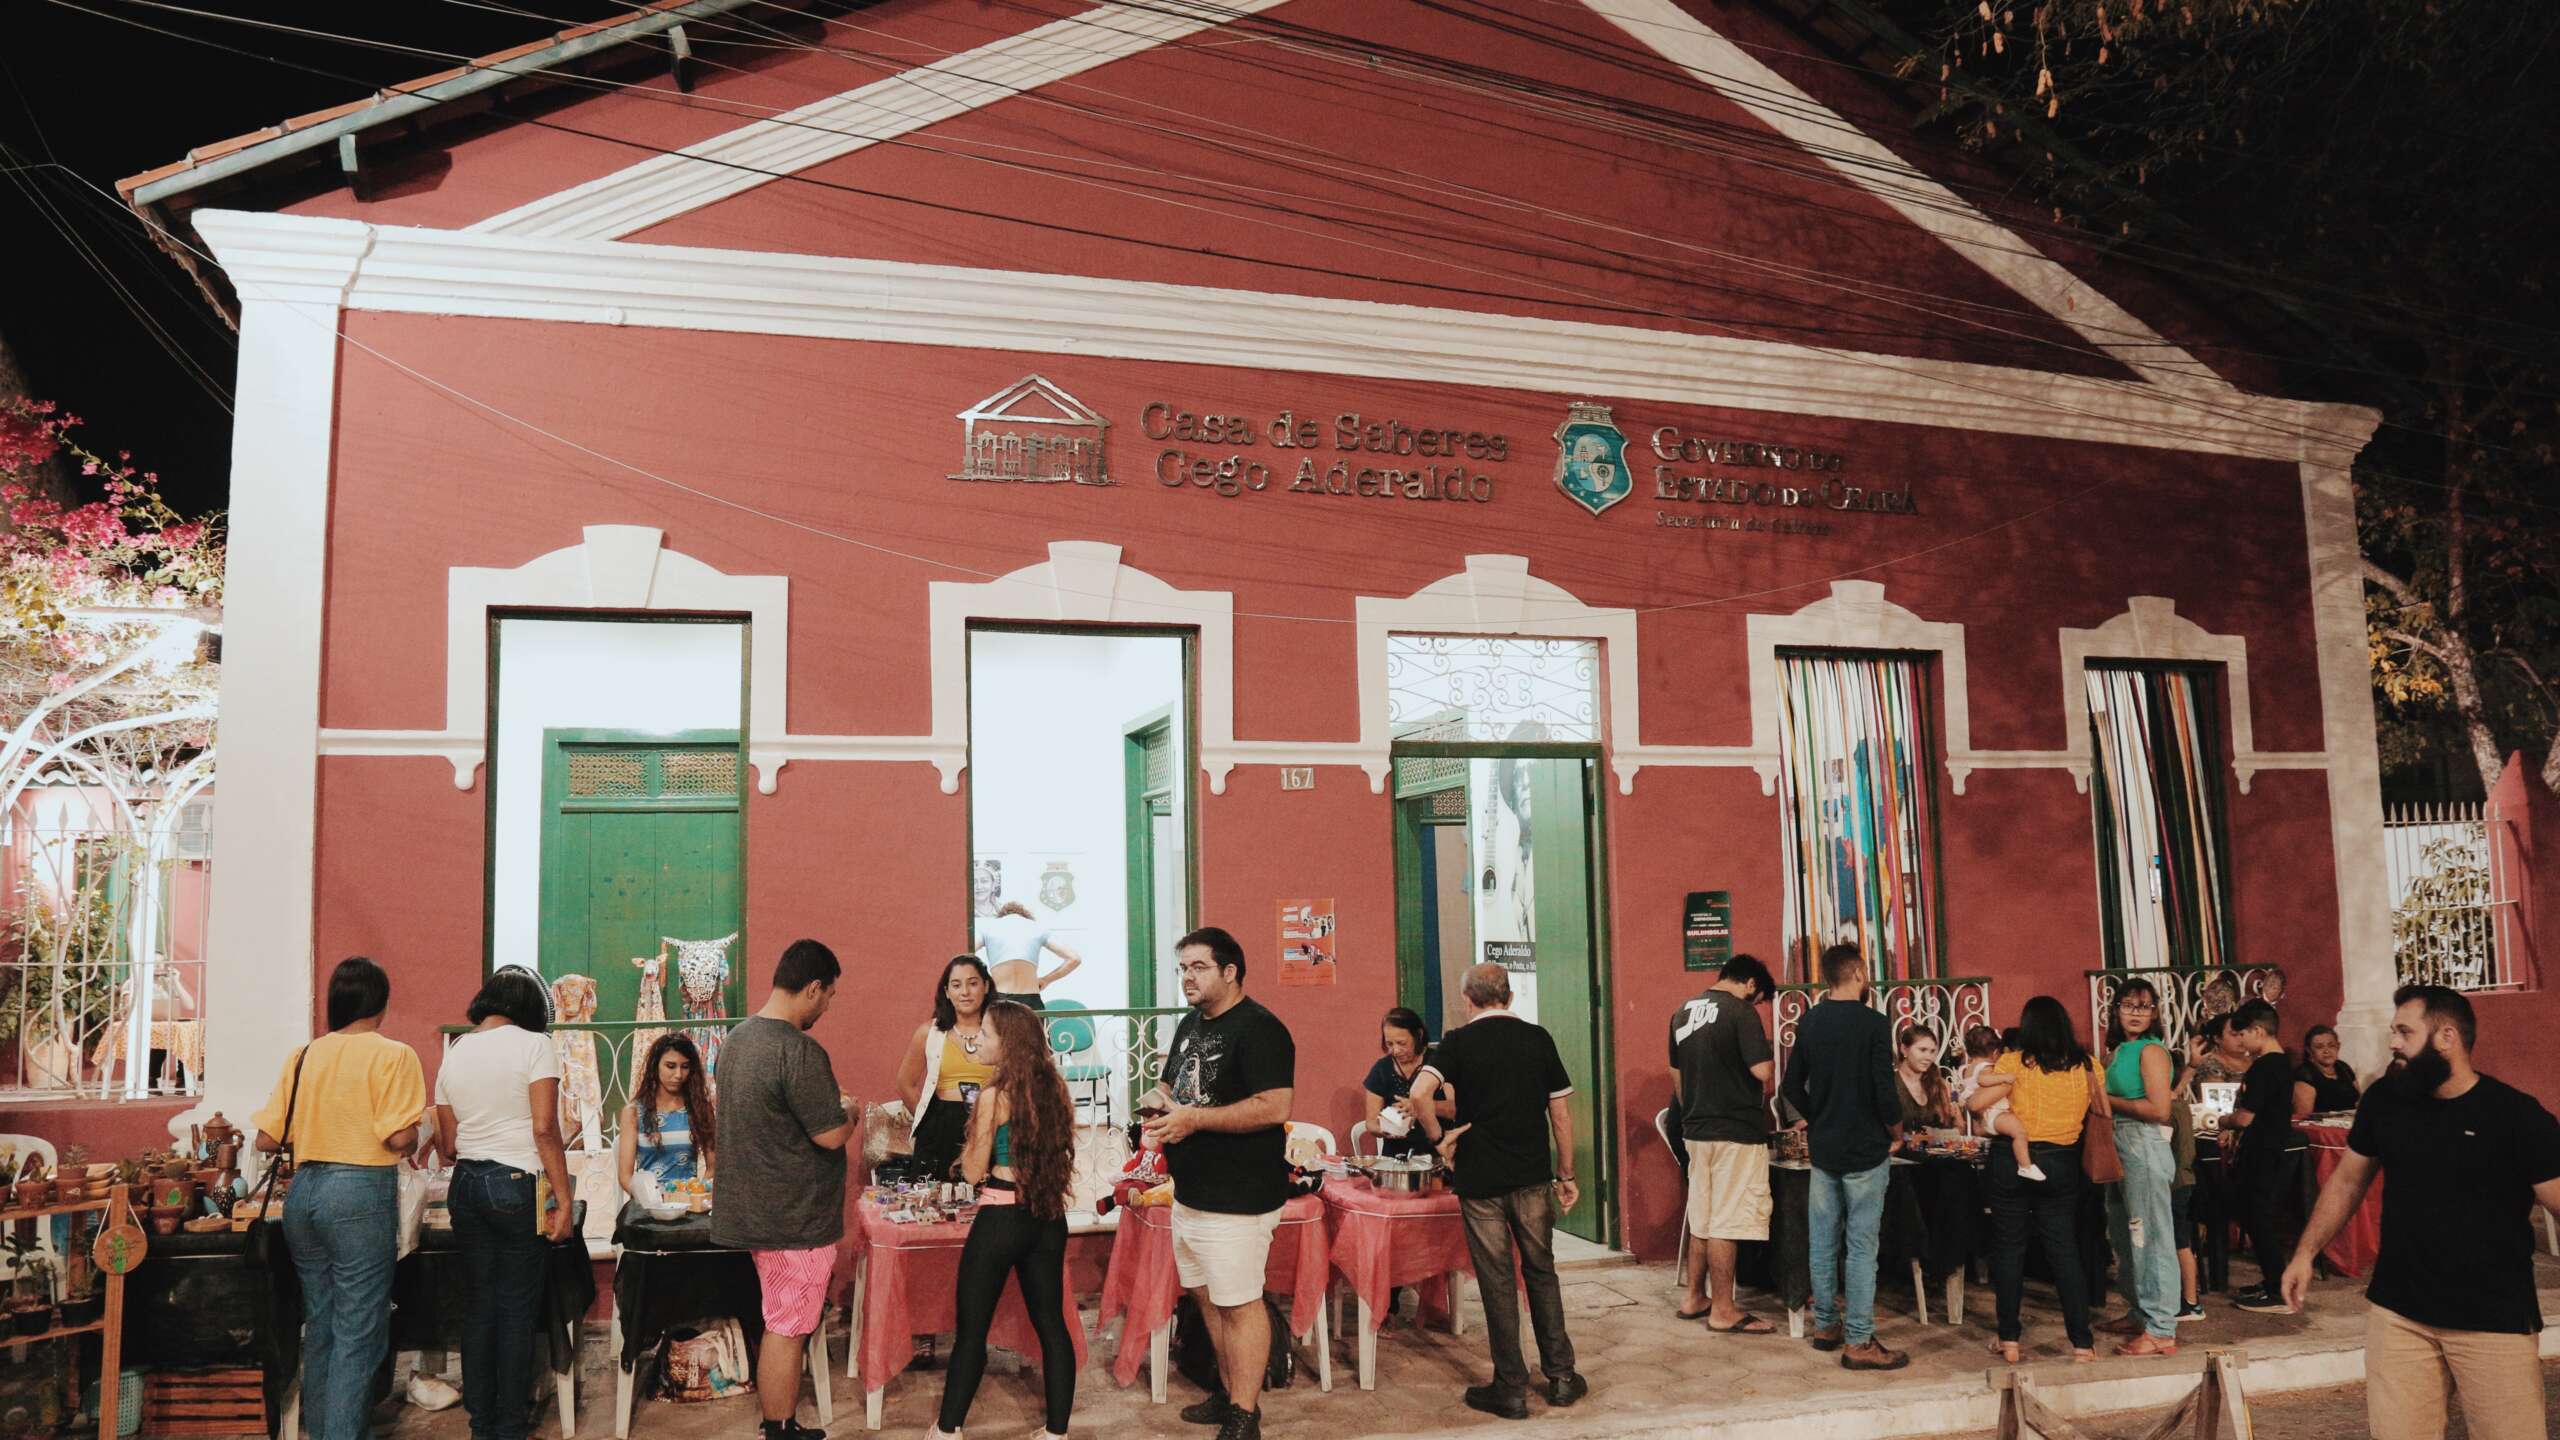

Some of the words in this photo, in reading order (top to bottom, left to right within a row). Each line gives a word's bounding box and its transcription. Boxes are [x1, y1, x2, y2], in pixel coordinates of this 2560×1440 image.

[1140, 401, 1255, 445] Casa
[1266, 410, 1320, 449] de
[1334, 412, 1509, 462] Saberes
[1155, 448, 1270, 497] Cego
[1288, 457, 1495, 502] Aderaldo
[1282, 767, 1313, 789] 167
[1487, 943, 1503, 959] Cego
[1504, 943, 1531, 957] Aderaldo
